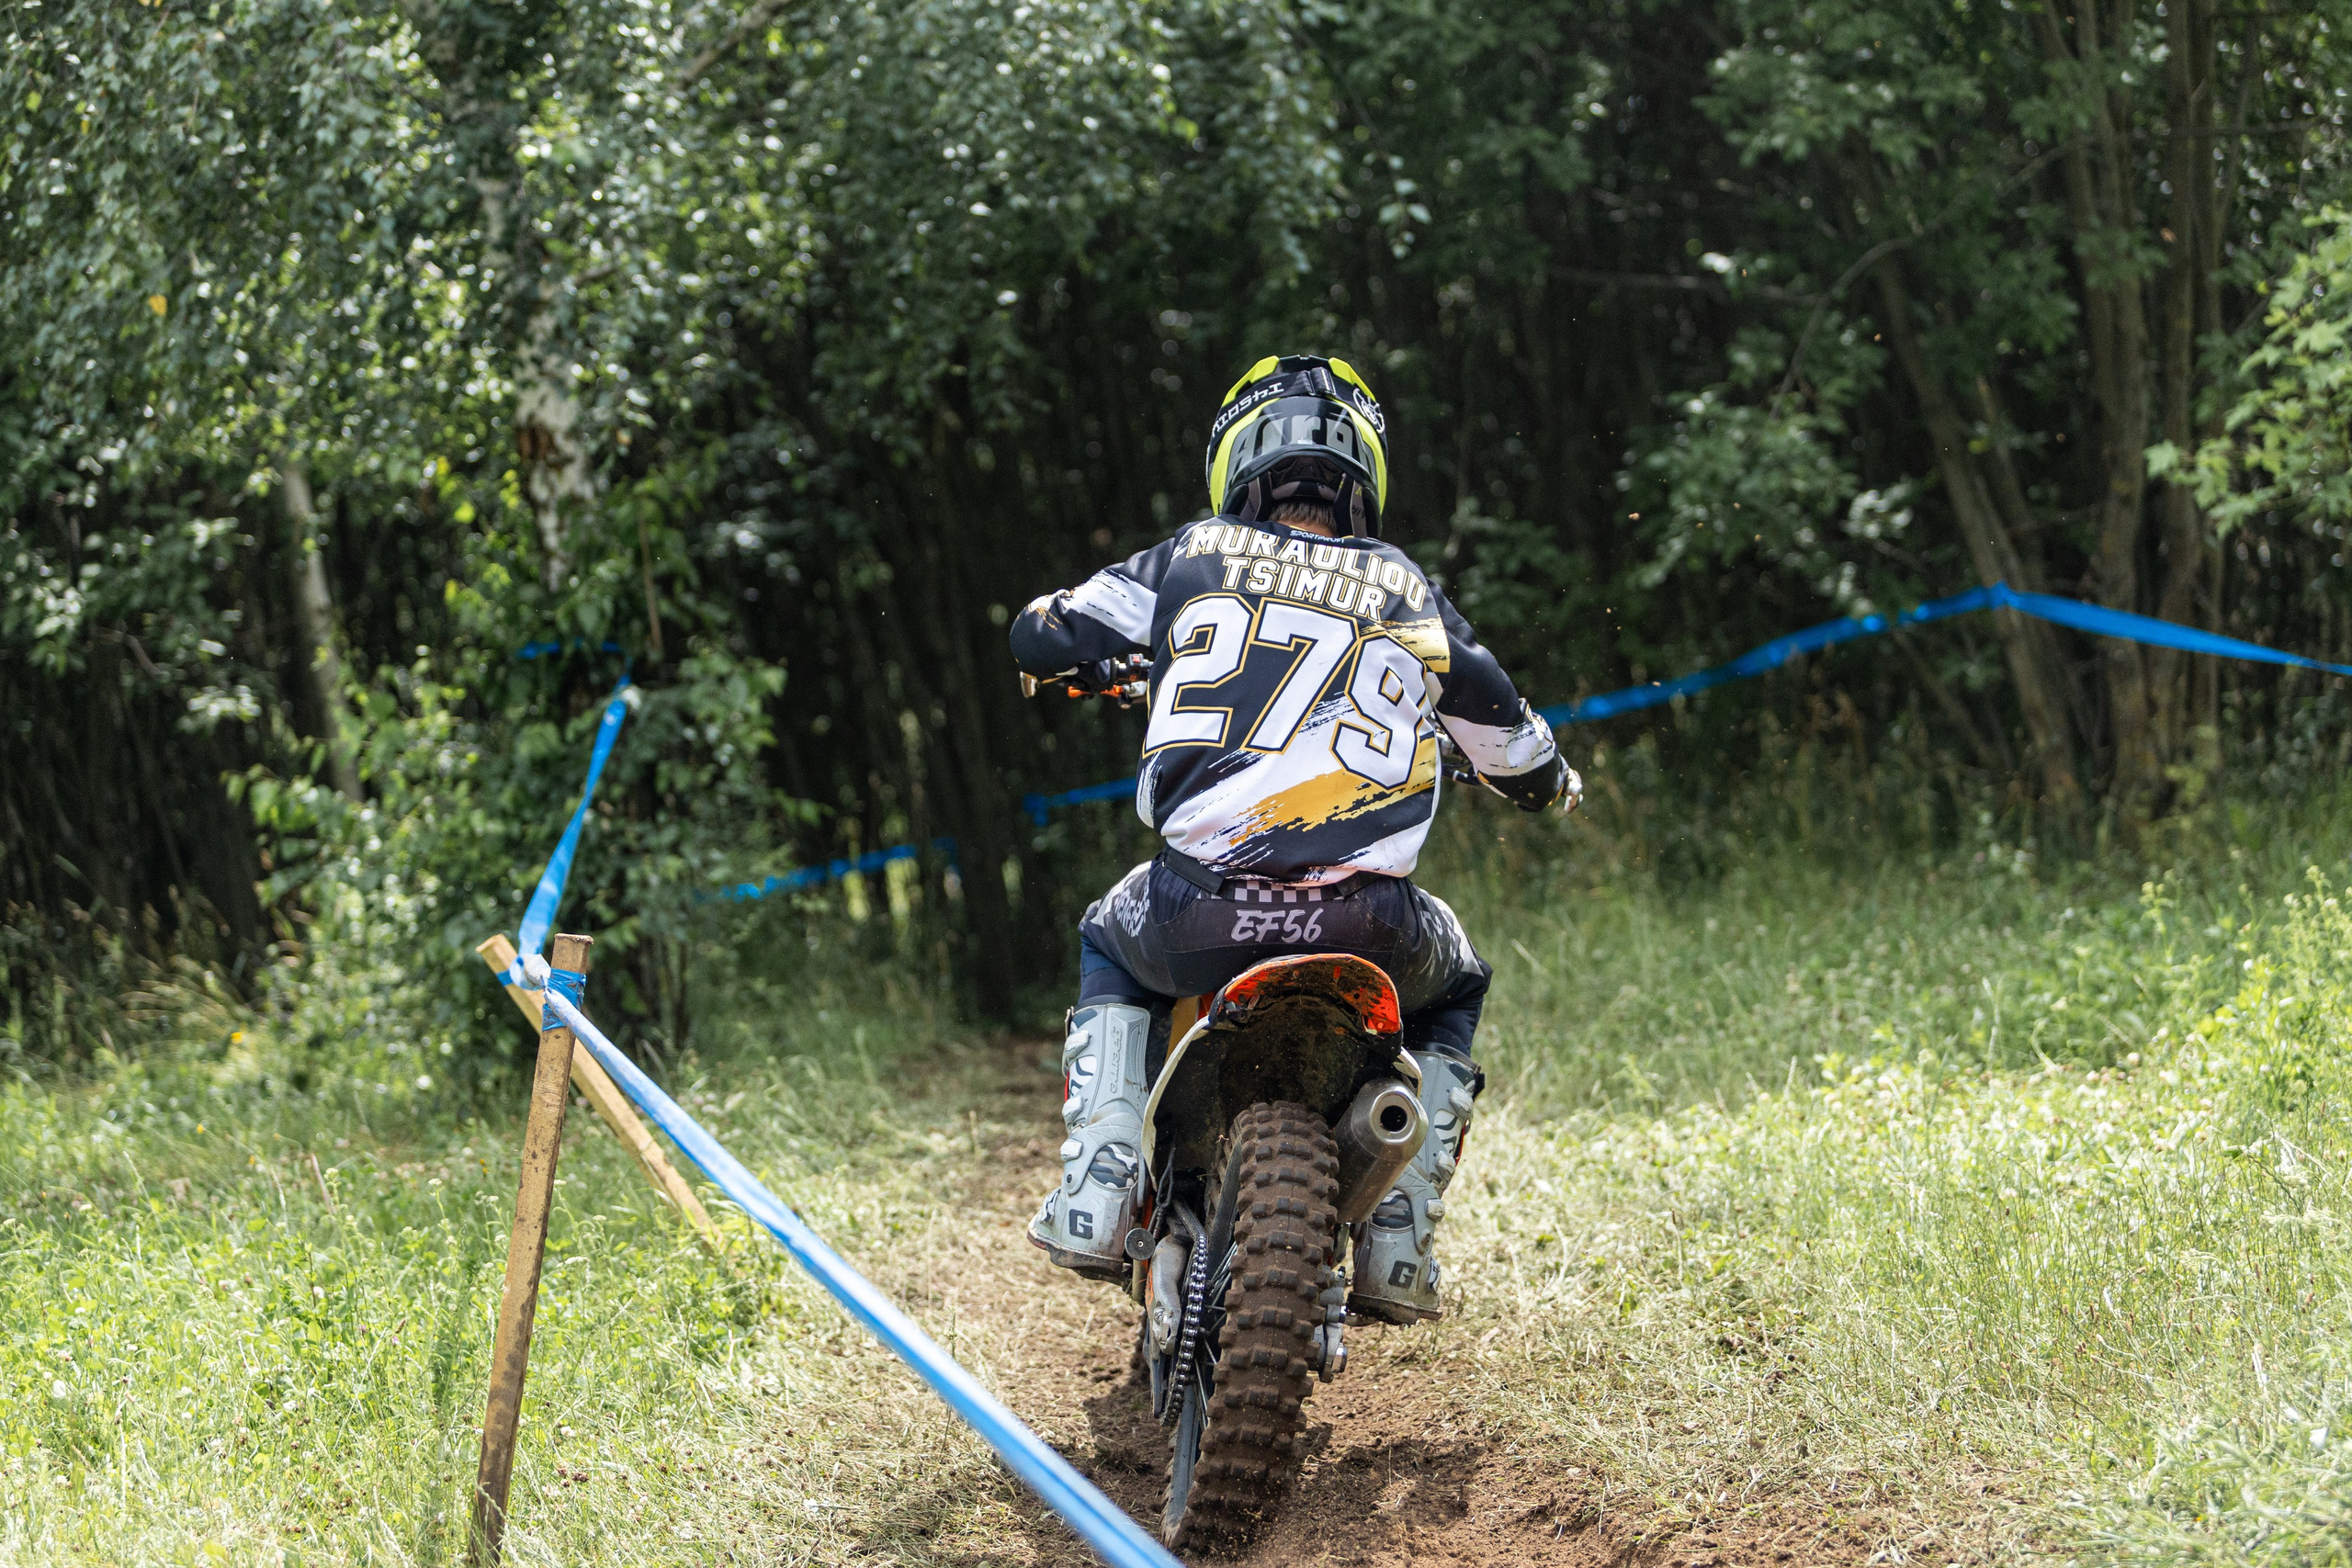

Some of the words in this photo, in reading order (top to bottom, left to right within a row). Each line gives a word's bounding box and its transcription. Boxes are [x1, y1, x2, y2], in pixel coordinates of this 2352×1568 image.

[1186, 525, 1426, 612] MURAULIOU
[1223, 556, 1386, 622] TSIMUR
[1143, 592, 1427, 791] 279
[1231, 907, 1323, 943] EF56
[1069, 1209, 1093, 1240] G
[1387, 1260, 1417, 1287] G
